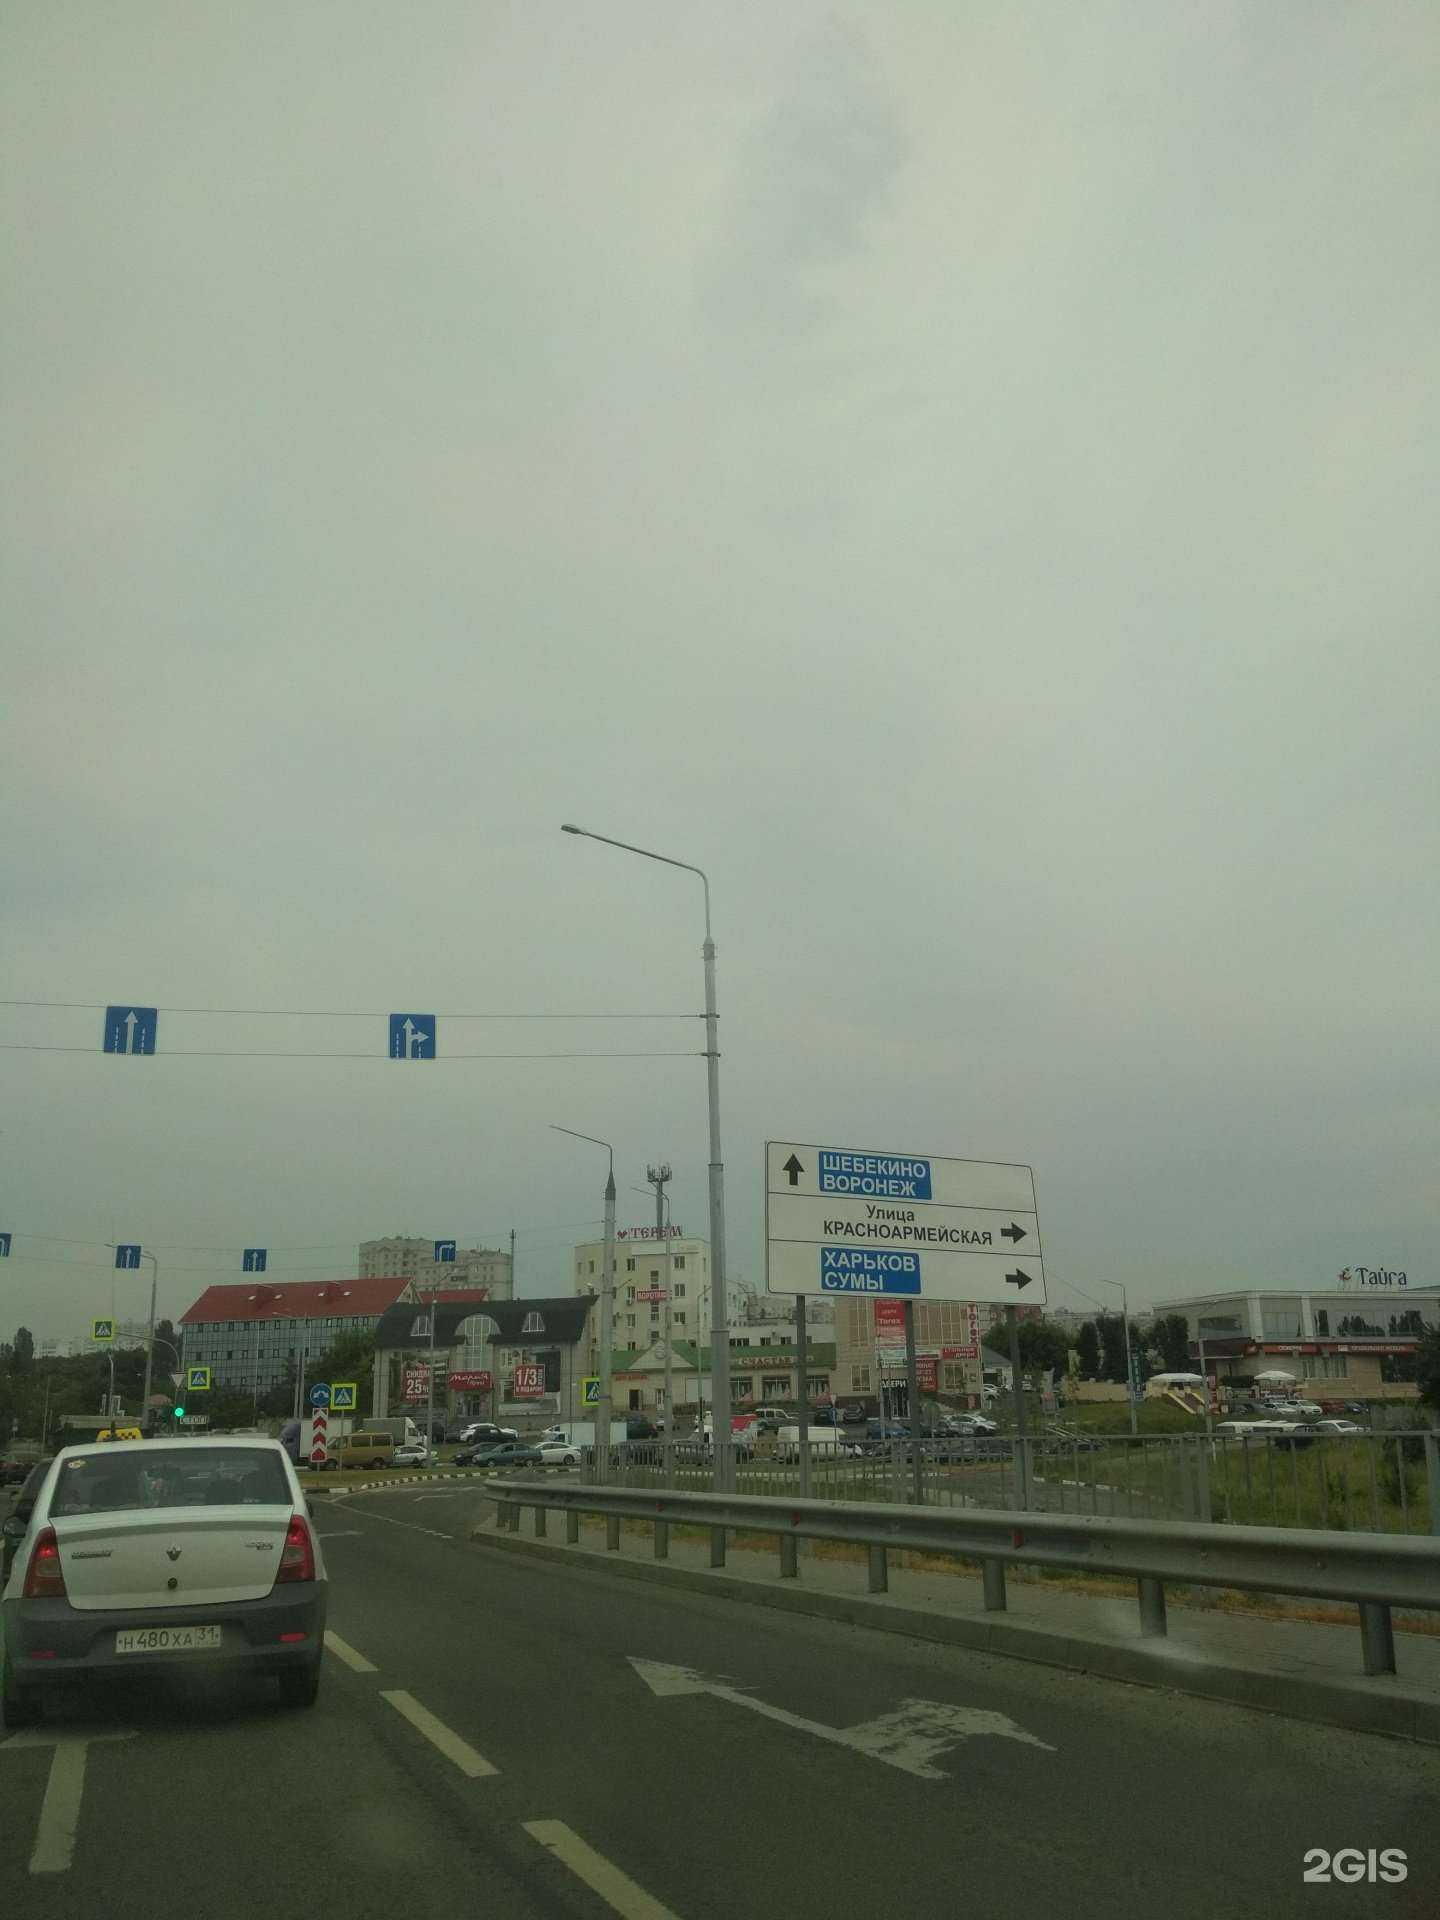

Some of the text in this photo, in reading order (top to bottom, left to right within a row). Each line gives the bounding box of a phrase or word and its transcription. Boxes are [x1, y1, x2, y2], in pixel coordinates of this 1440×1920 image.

[823, 1155, 926, 1178] ШЕБЕКИНО
[823, 1175, 917, 1197] ВОРОНЕЖ
[866, 1204, 915, 1223] Улица
[823, 1220, 993, 1246] КРАСНОАРМЕЙСКАЯ
[824, 1250, 917, 1272] ХАРЬКОВ
[824, 1271, 884, 1291] СУМЫ
[1355, 1267, 1407, 1286] Тайга
